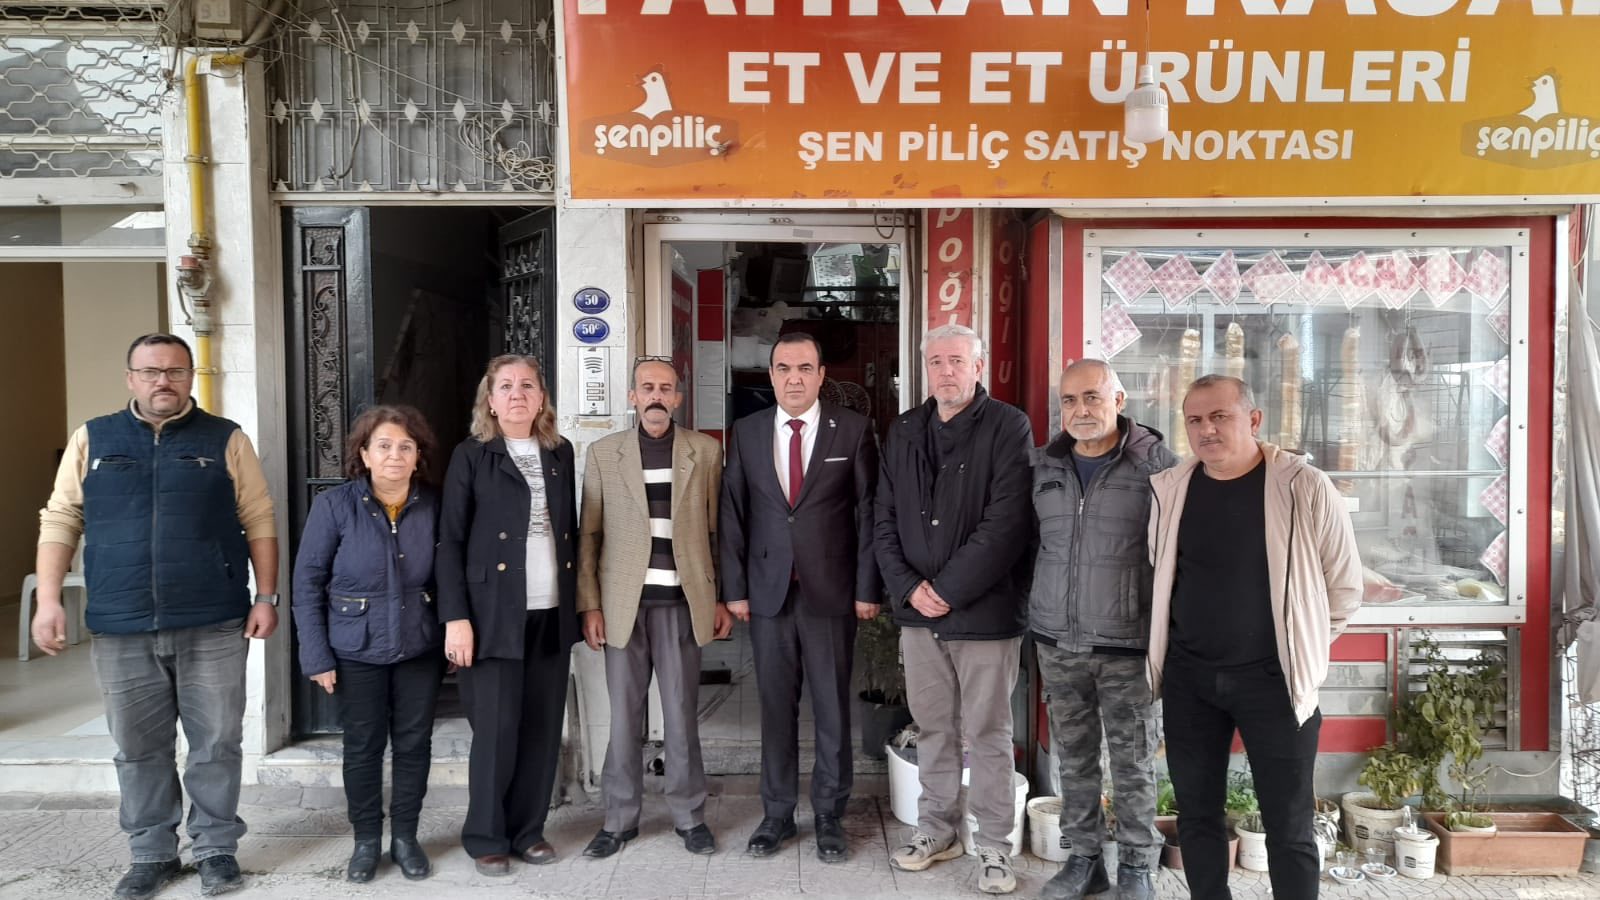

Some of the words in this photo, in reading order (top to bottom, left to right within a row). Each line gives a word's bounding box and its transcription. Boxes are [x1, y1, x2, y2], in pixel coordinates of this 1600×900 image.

[728, 51, 820, 104] ET
[845, 51, 941, 104] VE
[969, 51, 1063, 104] ET
[1089, 37, 1471, 104] ÜRÜNLERİ
[594, 115, 721, 156] şenpiliç
[799, 131, 883, 170] ŞEN
[899, 123, 1009, 170] PİLİÇ
[1162, 130, 1353, 161] NOKTASI
[584, 294, 599, 306] 50
